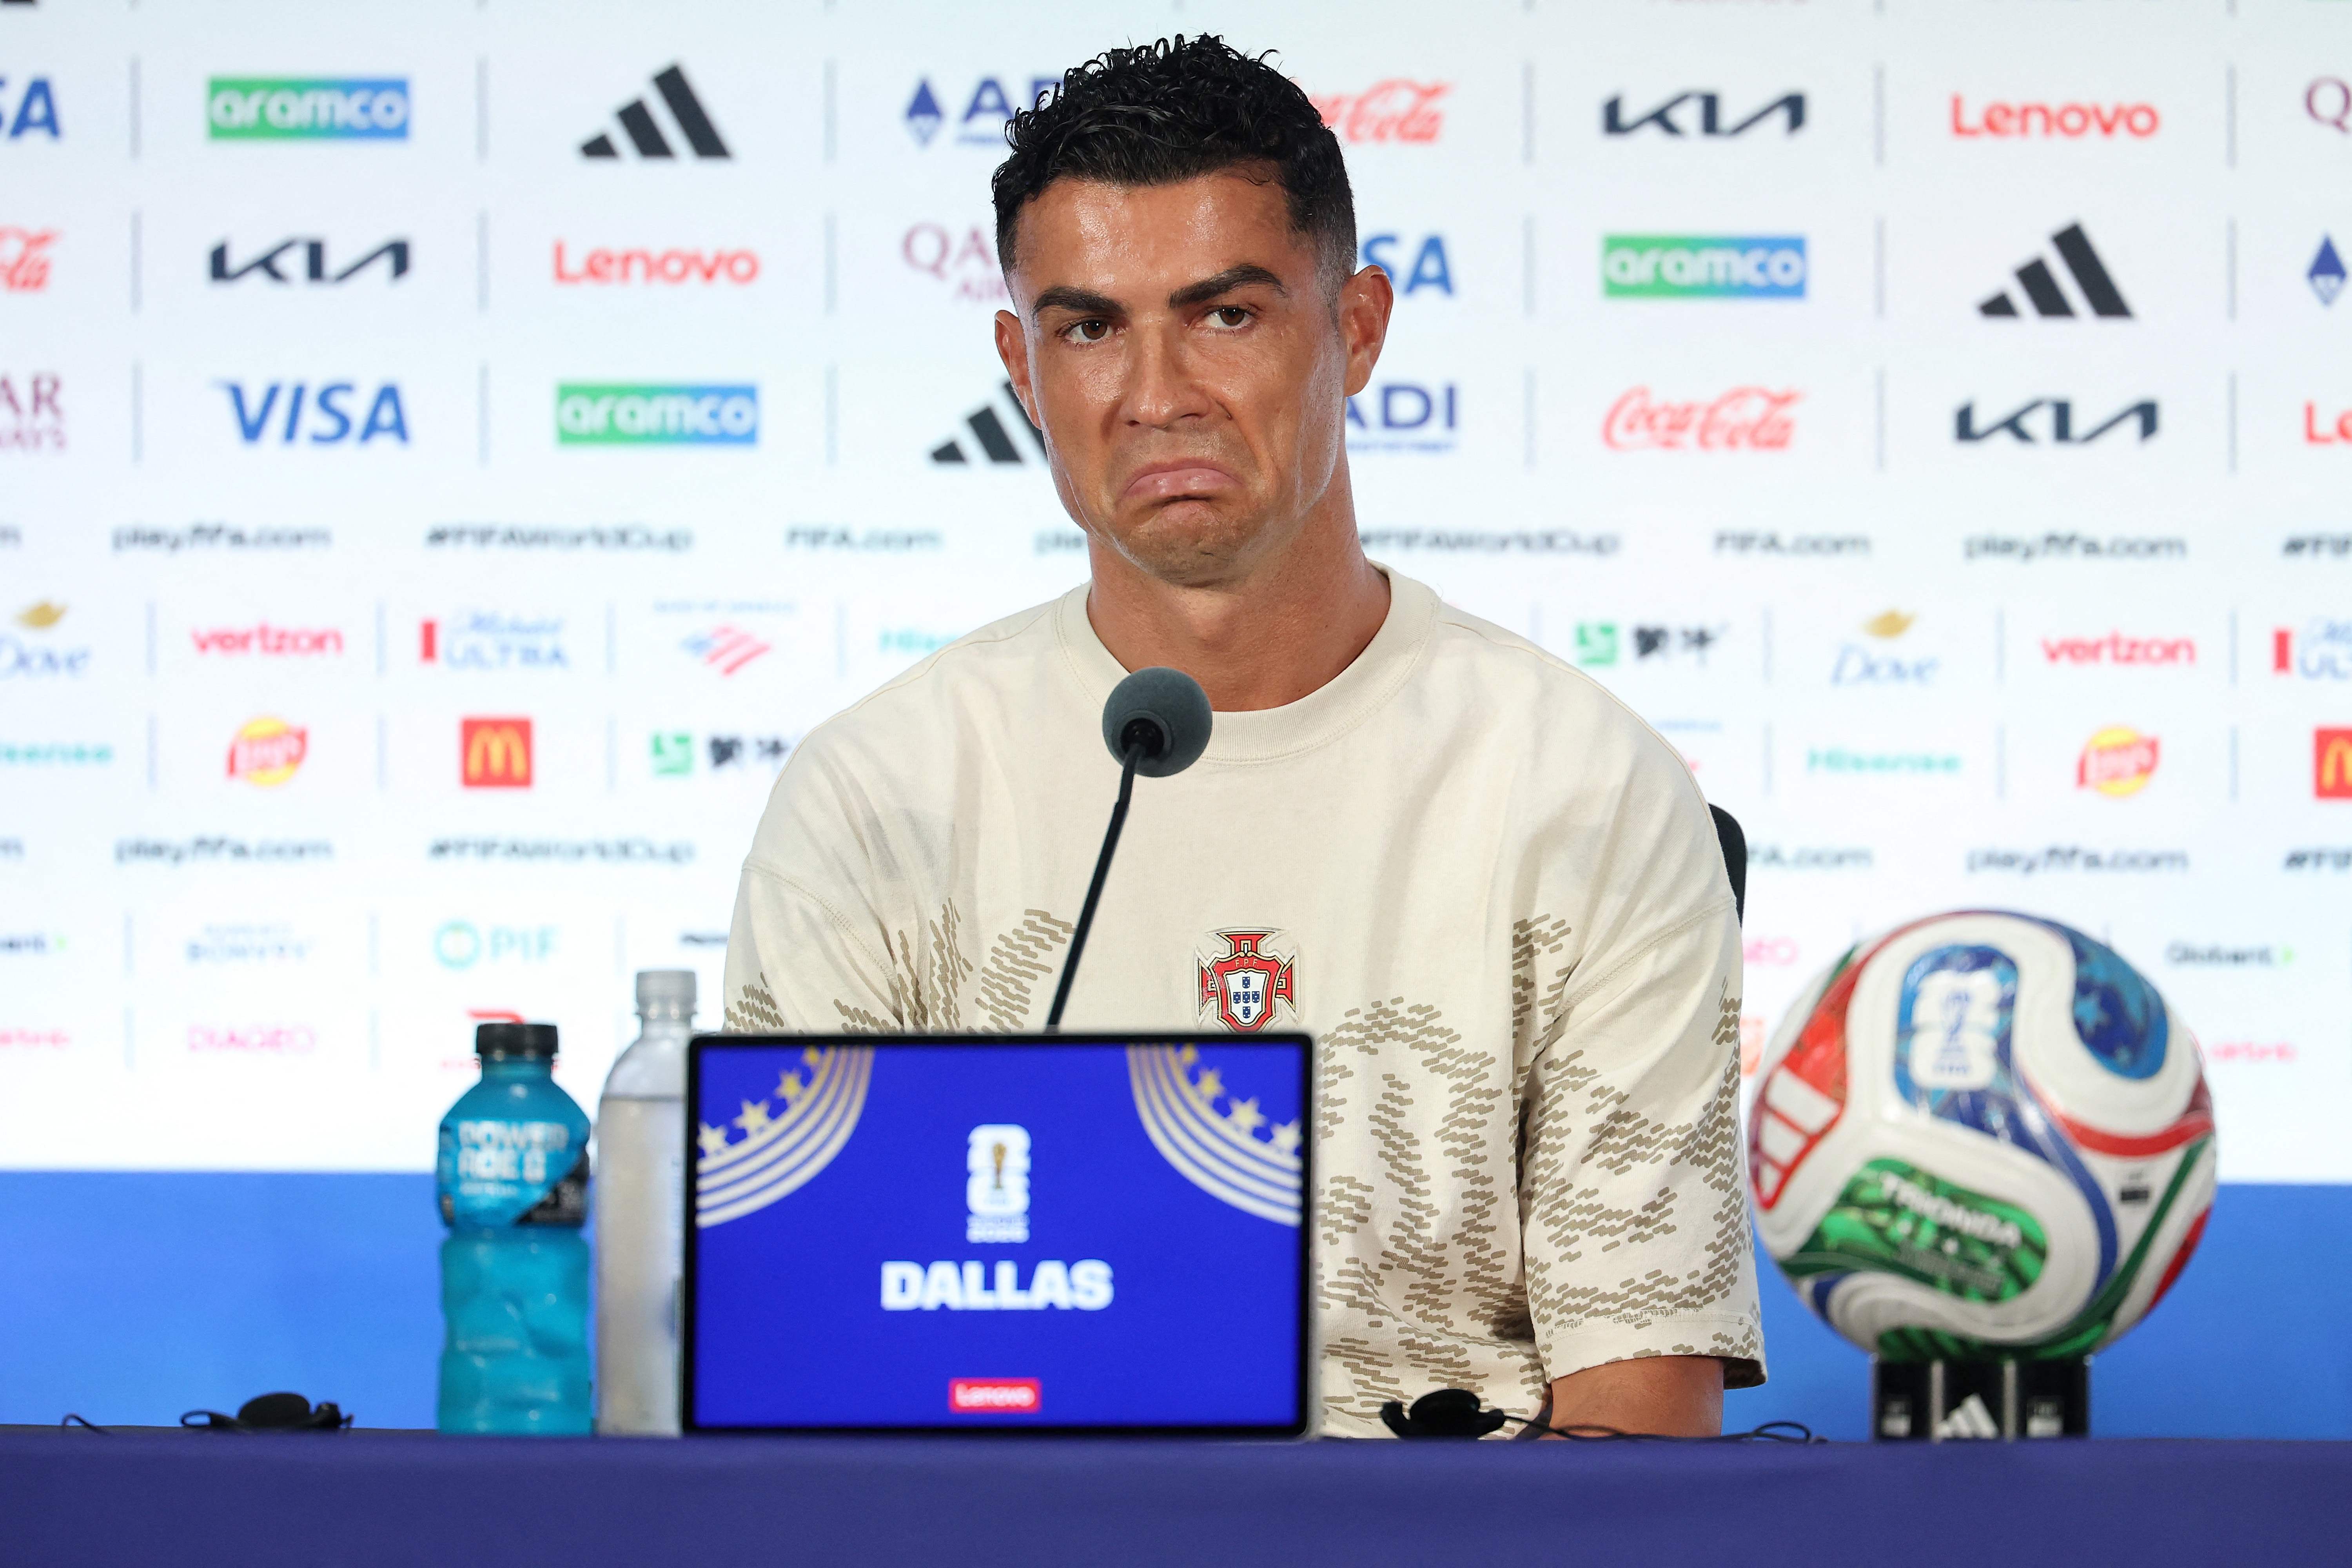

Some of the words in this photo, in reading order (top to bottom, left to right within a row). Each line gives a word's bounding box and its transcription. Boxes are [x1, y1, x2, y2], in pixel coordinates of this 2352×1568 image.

[210, 89, 406, 129] aramco
[1602, 92, 1806, 136] KIA
[1951, 95, 2159, 137] Lenovo
[209, 238, 408, 283] KIA
[554, 241, 759, 283] Lenovo
[1605, 245, 1803, 287] aramco
[218, 383, 409, 443] VISA
[561, 395, 757, 436] aramco
[1954, 401, 2159, 443] KIA
[191, 624, 343, 654] verizon
[2042, 631, 2196, 662] verizon
[1831, 643, 1938, 686] Dove
[1235, 958, 1259, 967] F.P.F.
[881, 1260, 1114, 1310] DALLAS
[955, 1388, 1035, 1406] Lenovo
